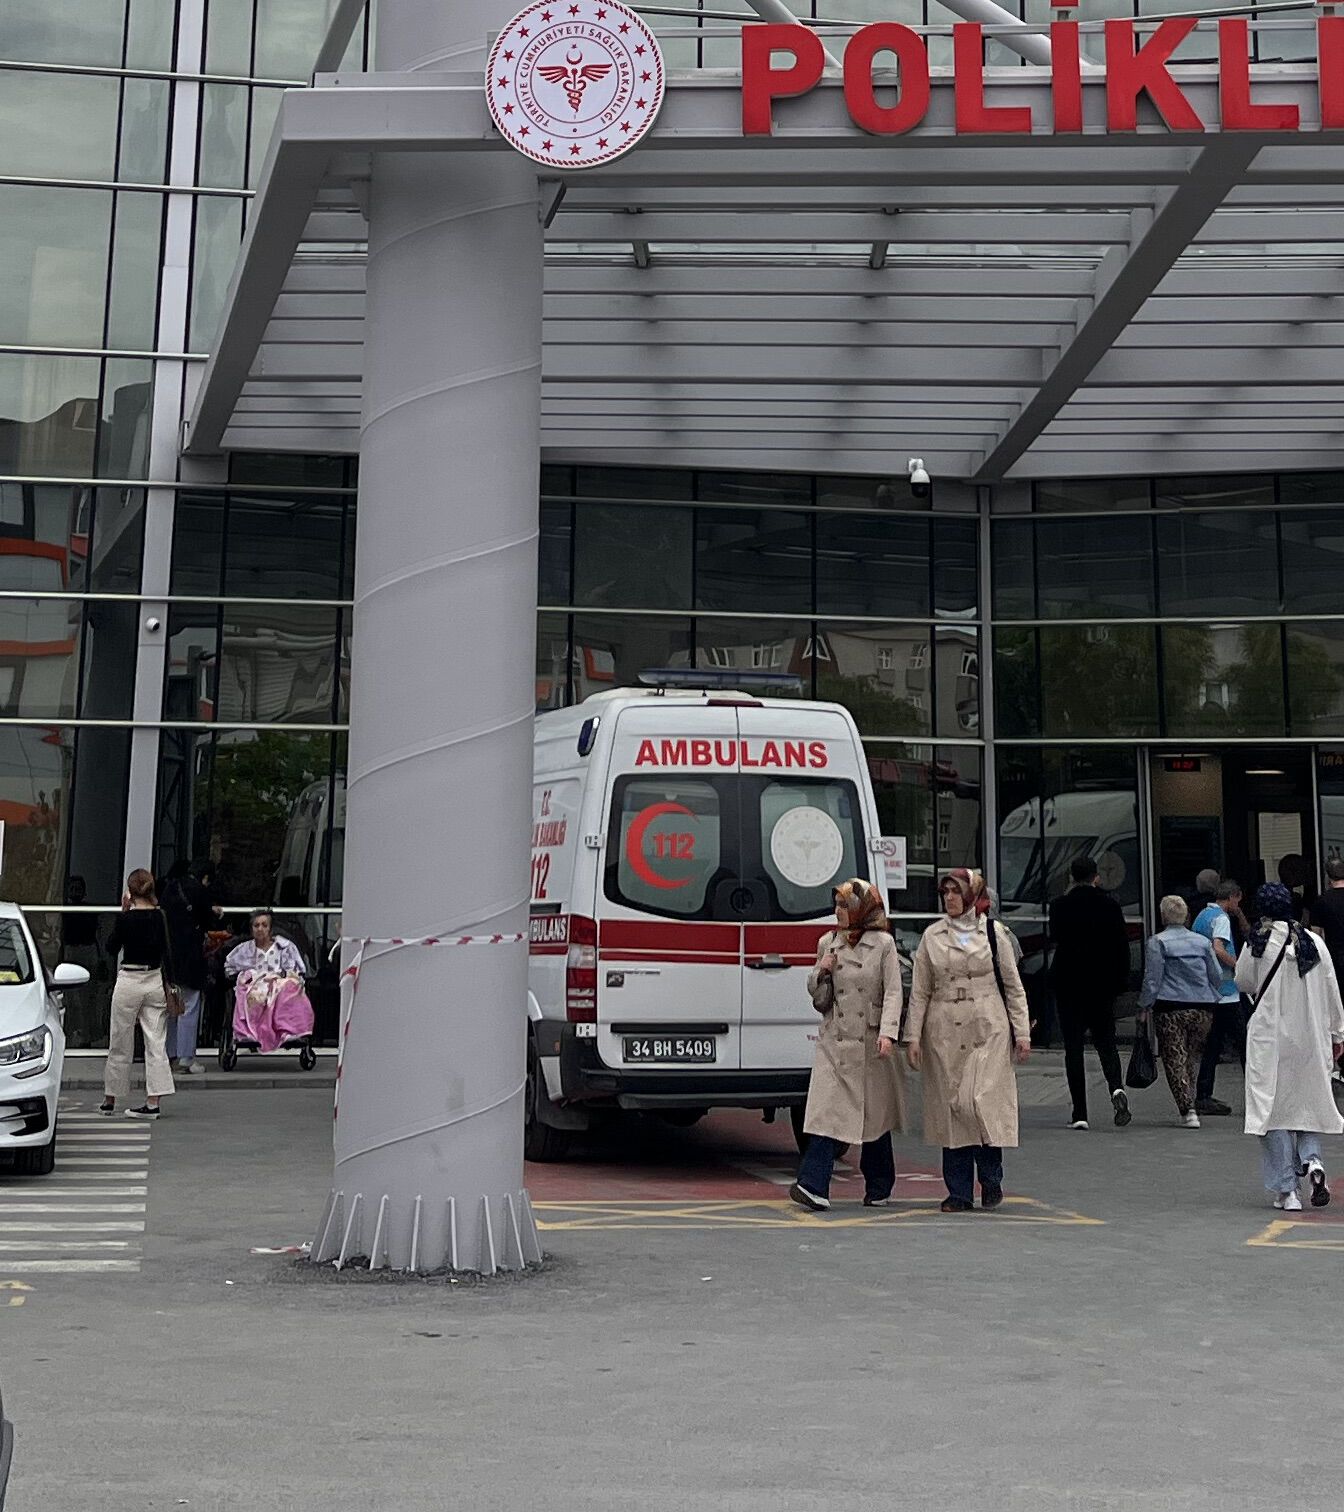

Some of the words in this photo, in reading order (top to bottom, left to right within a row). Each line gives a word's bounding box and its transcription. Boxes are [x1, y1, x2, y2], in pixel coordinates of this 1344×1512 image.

[521, 24, 585, 78] CUMHURİYETİ
[635, 739, 828, 769] AMBULANS
[653, 831, 696, 860] 112
[530, 918, 567, 942] BULANS
[632, 1040, 650, 1056] 34
[654, 1040, 672, 1056] BH
[676, 1040, 712, 1056] 5409
